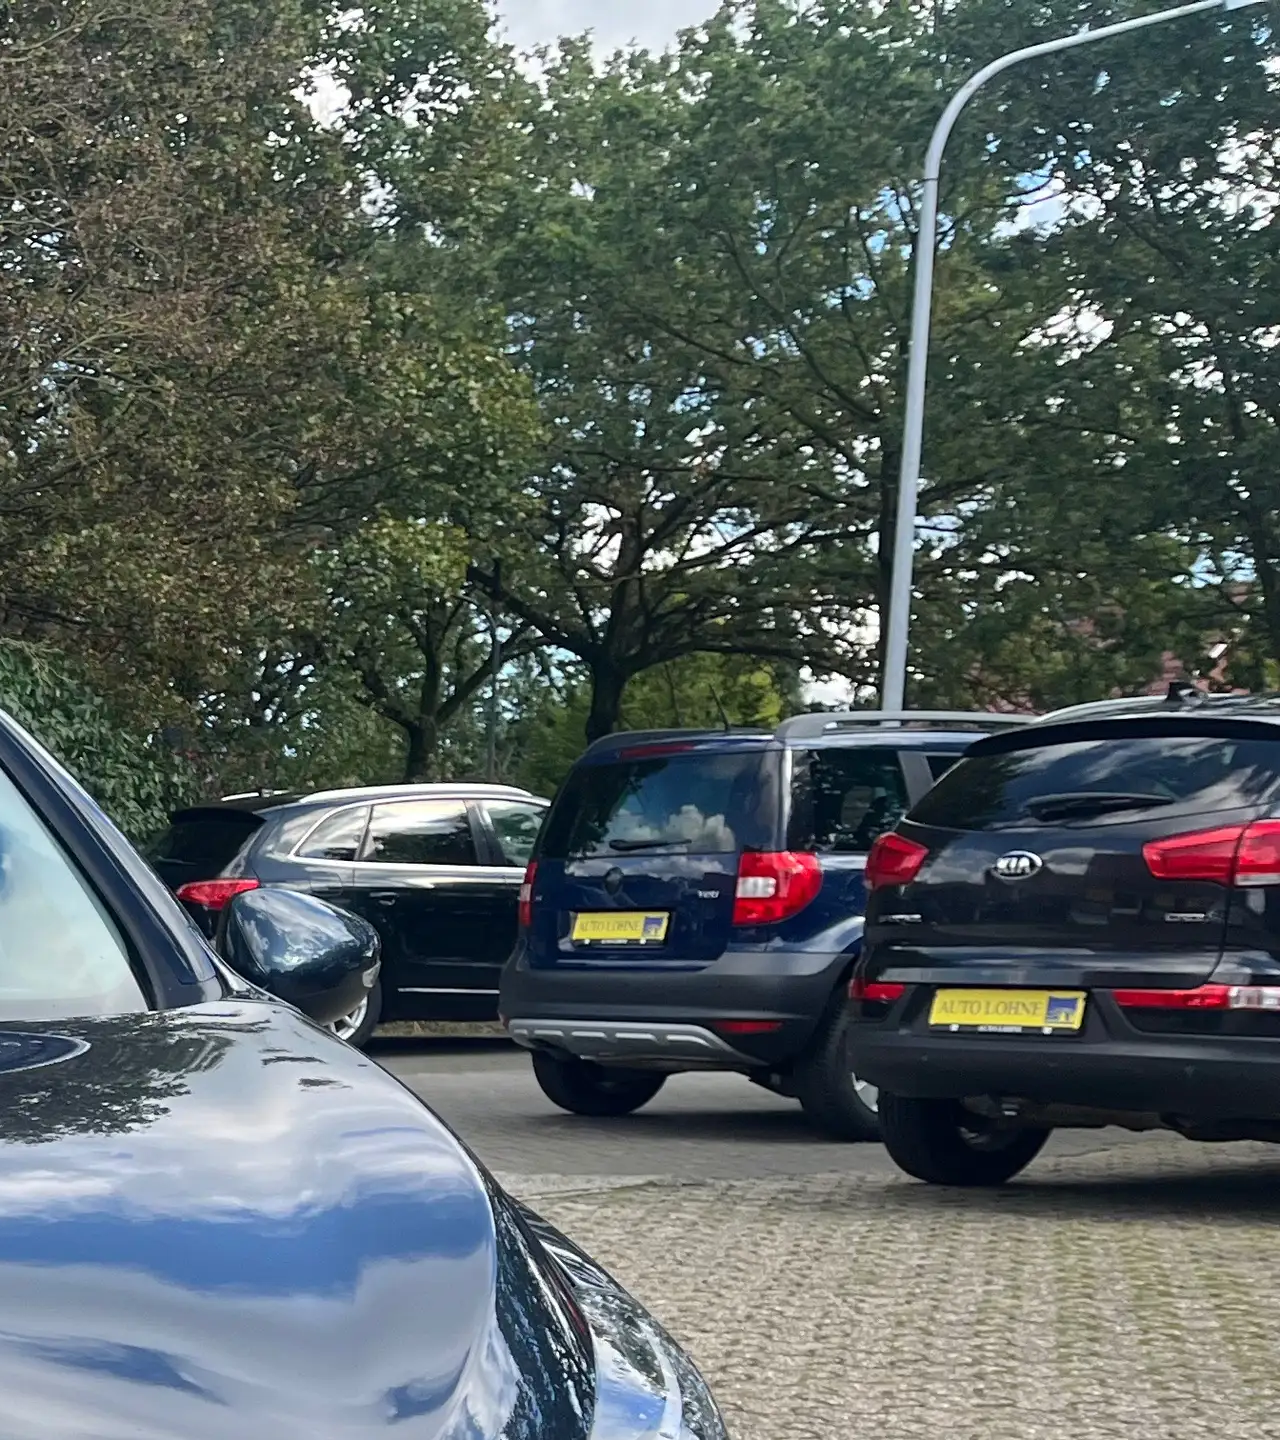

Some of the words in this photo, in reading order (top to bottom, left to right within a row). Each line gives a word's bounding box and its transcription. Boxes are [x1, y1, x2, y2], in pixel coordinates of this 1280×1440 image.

[996, 856, 1031, 874] KIA
[938, 1000, 981, 1015] AUTO
[985, 1000, 1042, 1016] LOHNE
